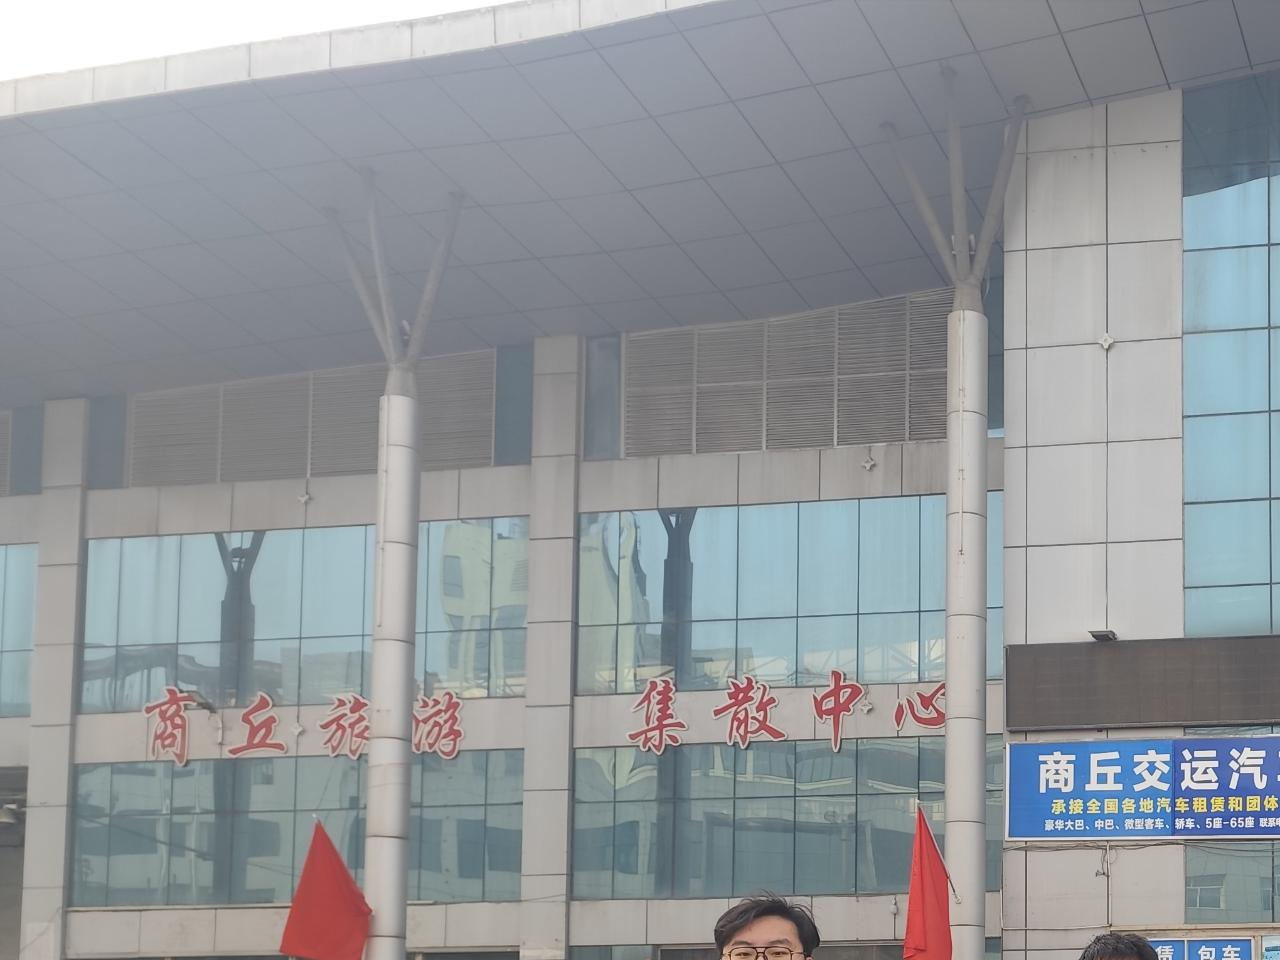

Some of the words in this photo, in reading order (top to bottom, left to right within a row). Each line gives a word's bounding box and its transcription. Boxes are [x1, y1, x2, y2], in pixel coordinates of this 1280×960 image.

[143, 686, 465, 767] 商丘旅游
[627, 669, 946, 755] 集散中心
